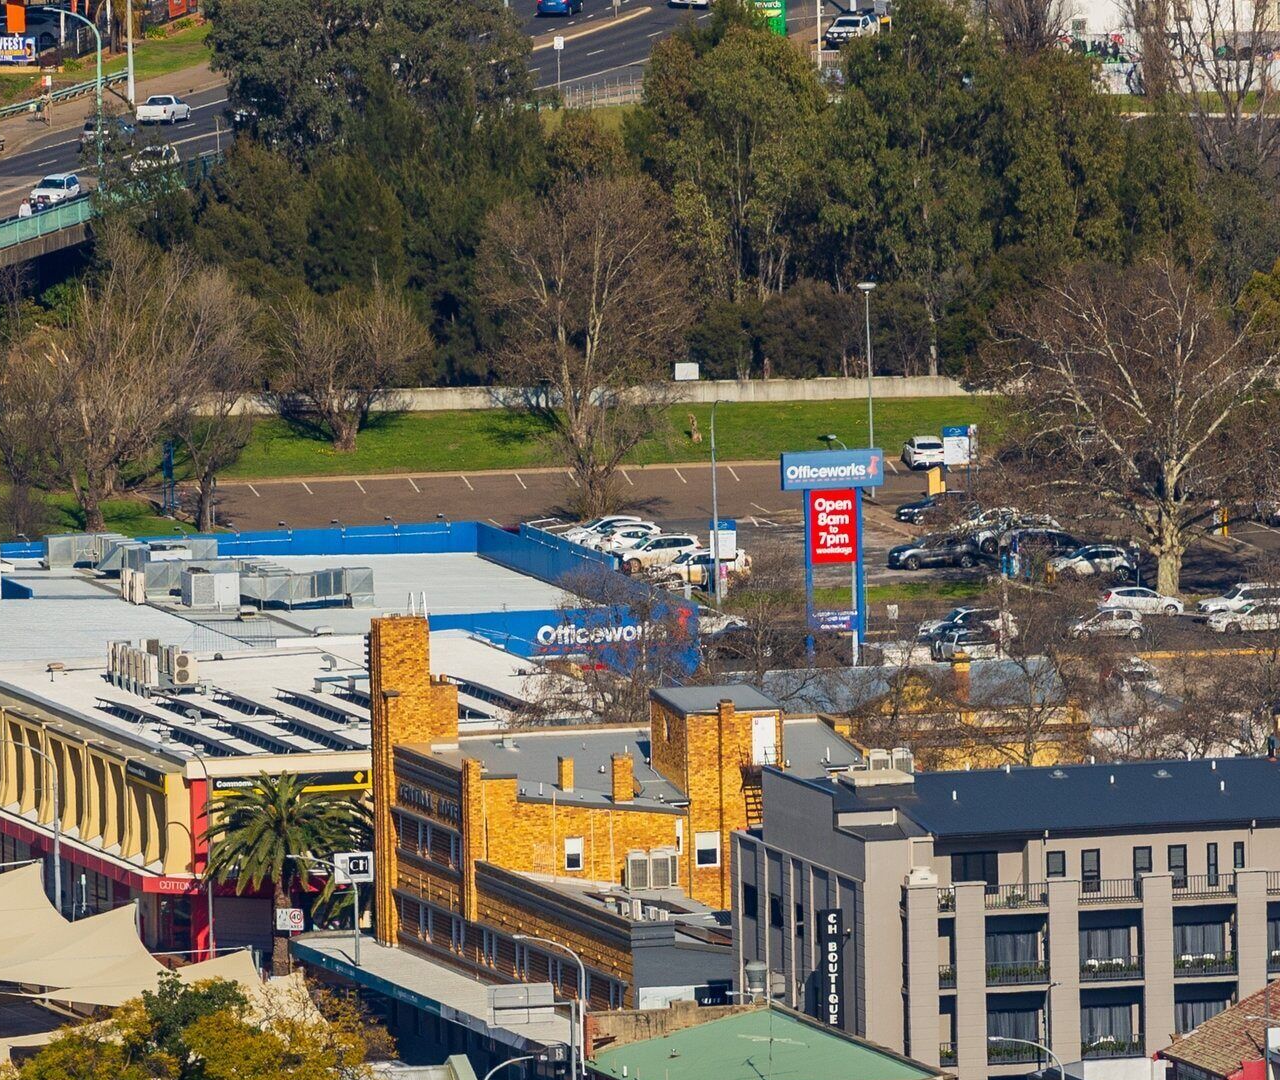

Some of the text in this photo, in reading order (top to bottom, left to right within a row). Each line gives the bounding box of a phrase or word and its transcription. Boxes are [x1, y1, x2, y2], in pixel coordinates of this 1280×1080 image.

[786, 463, 866, 479] Officeworks
[814, 498, 852, 513] Open
[817, 512, 850, 526] 8am
[828, 525, 839, 533] to
[818, 532, 849, 547] 7pm
[815, 547, 853, 555] weekdays
[350, 859, 368, 872] CH
[159, 879, 190, 891] COTTON
[292, 912, 301, 921] 40
[827, 942, 839, 1025] BOUTIQUE
